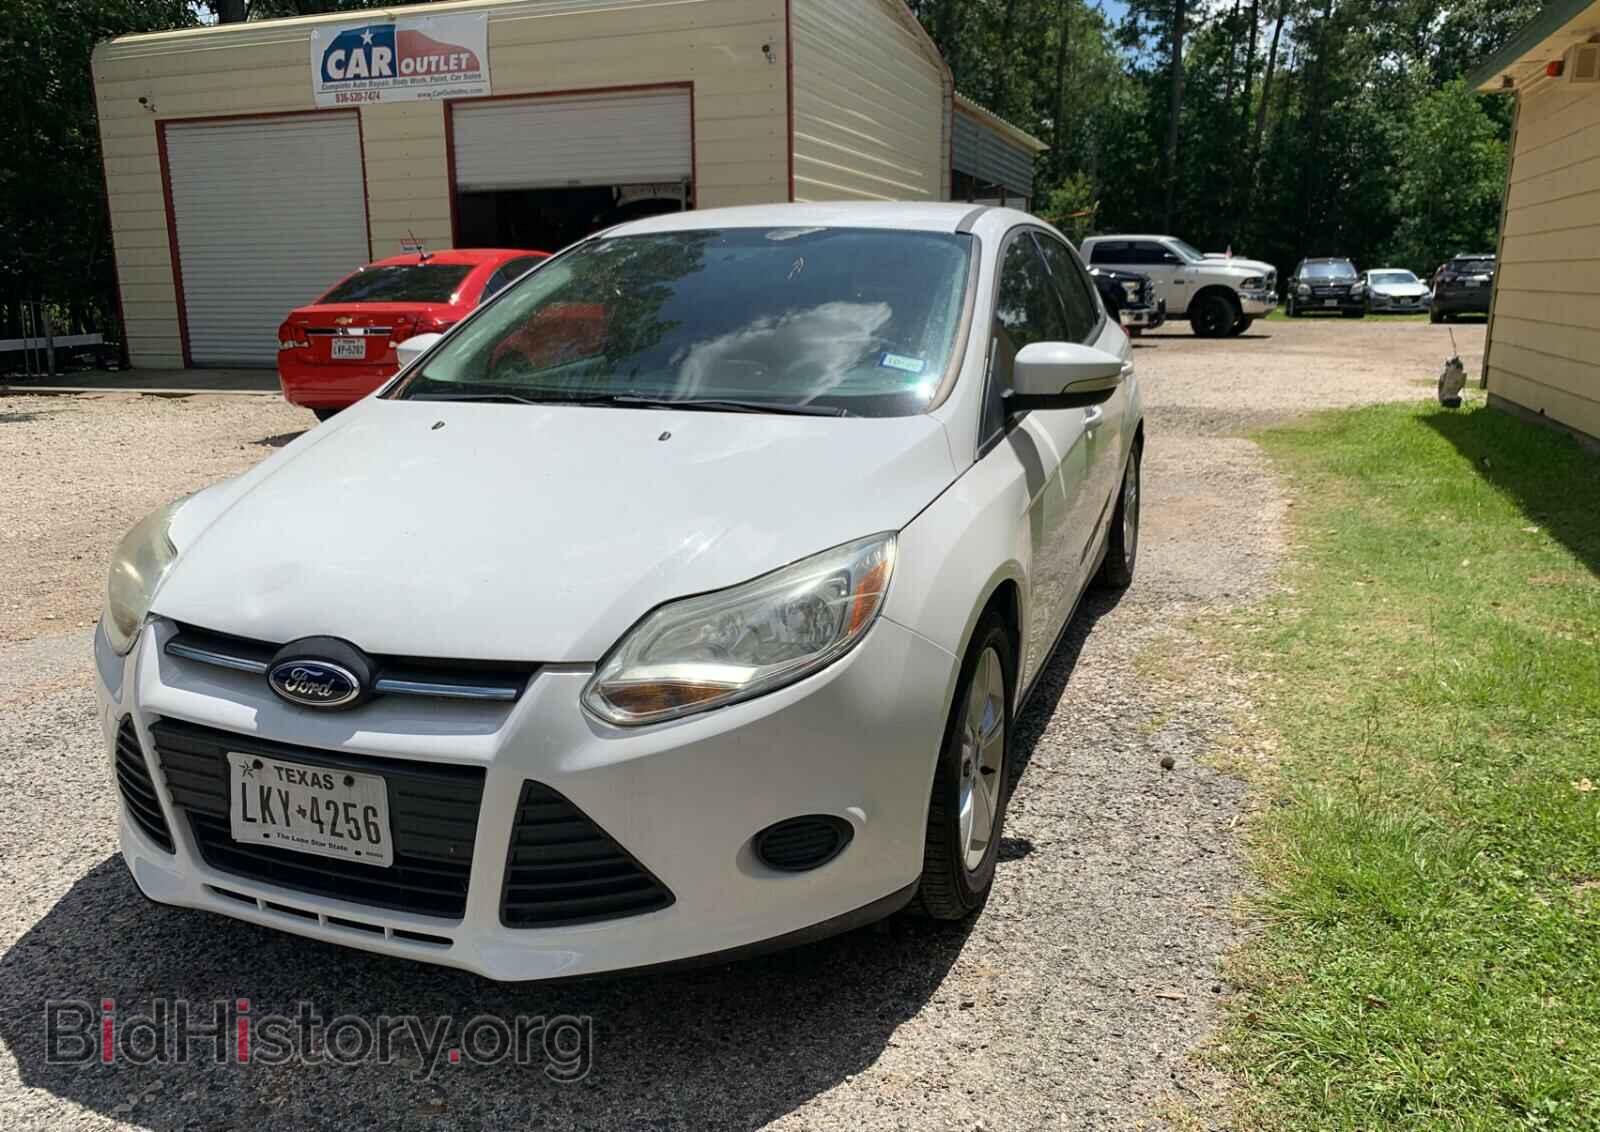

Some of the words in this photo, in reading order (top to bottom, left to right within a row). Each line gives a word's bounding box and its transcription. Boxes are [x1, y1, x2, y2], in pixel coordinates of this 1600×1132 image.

[327, 46, 393, 80] CAR
[400, 52, 472, 75] OUTLET
[284, 667, 336, 697] Ford
[274, 765, 335, 791] TEXAS
[276, 832, 290, 841] The
[291, 835, 310, 845] Lone
[311, 839, 327, 849] Star
[328, 842, 348, 852] State
